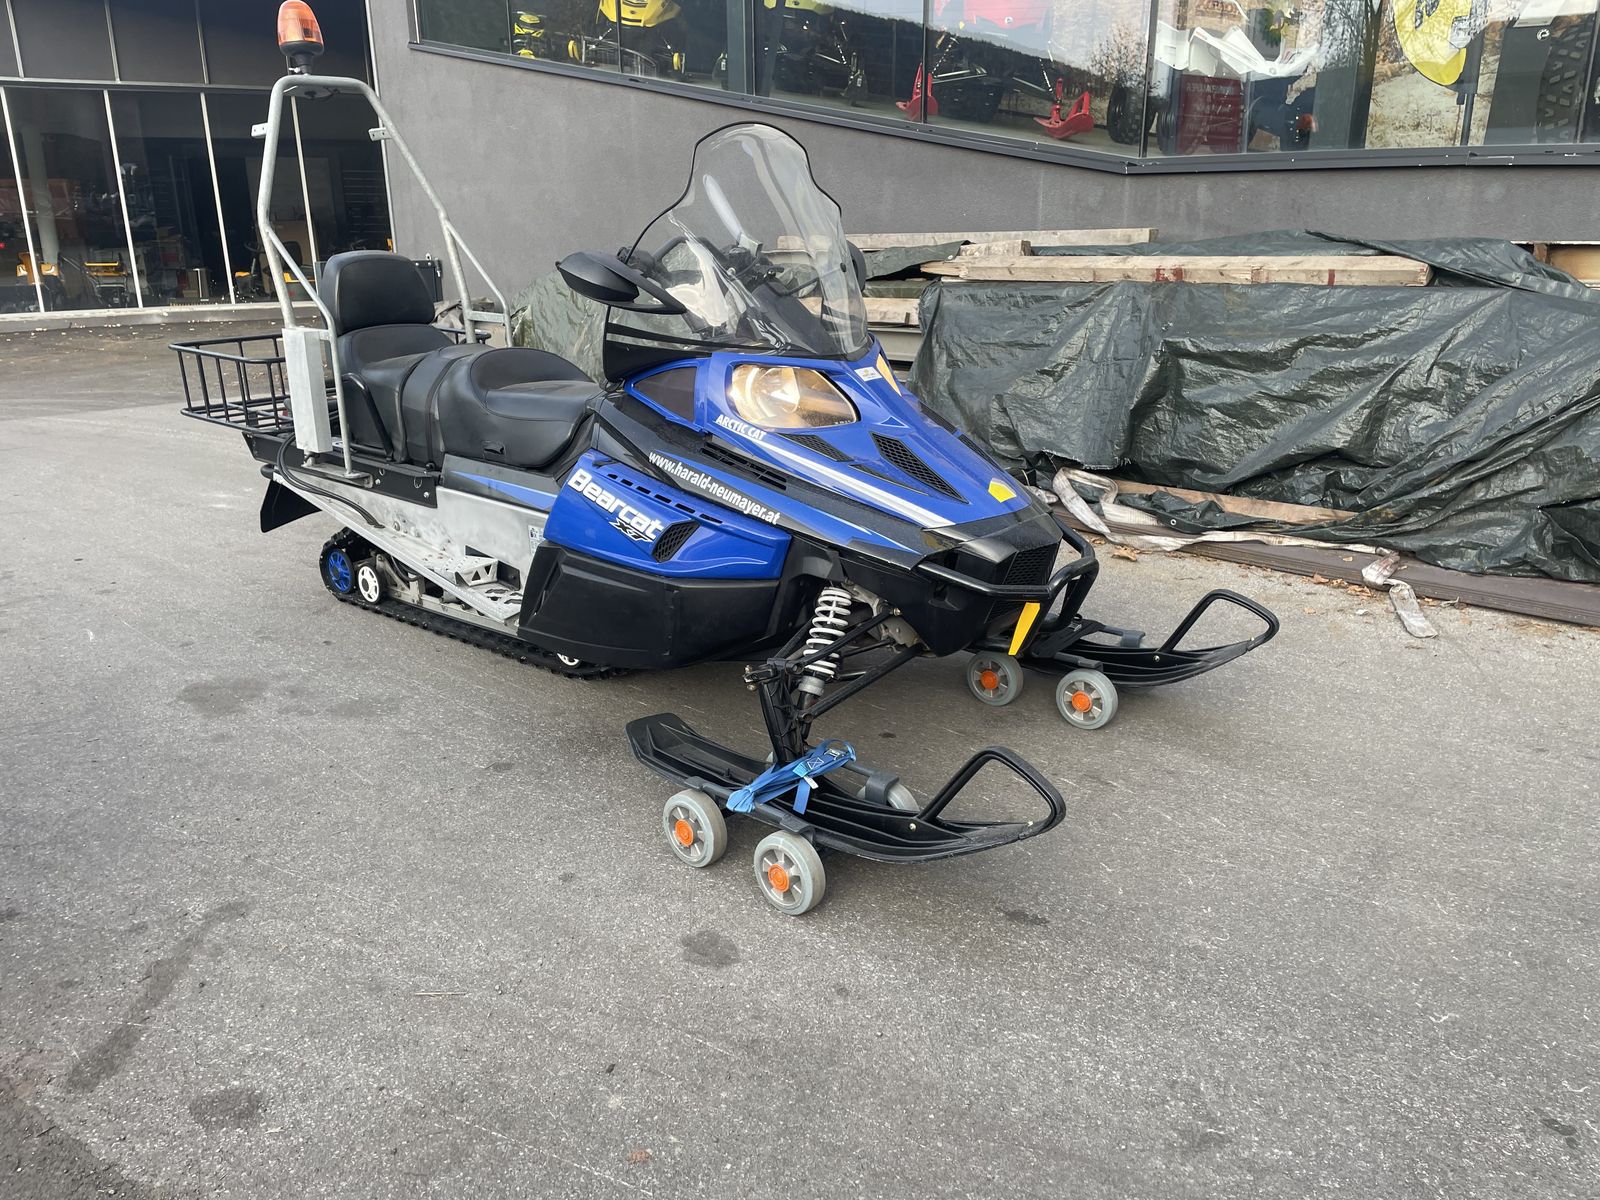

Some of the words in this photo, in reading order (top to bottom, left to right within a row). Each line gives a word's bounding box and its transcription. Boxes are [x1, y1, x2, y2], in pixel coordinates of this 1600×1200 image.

[715, 414, 749, 434] ARCTIC
[748, 427, 767, 441] CAT
[567, 468, 665, 540] Bearcat
[648, 451, 781, 525] www.harald-neumayer.at
[608, 517, 655, 543] XT
